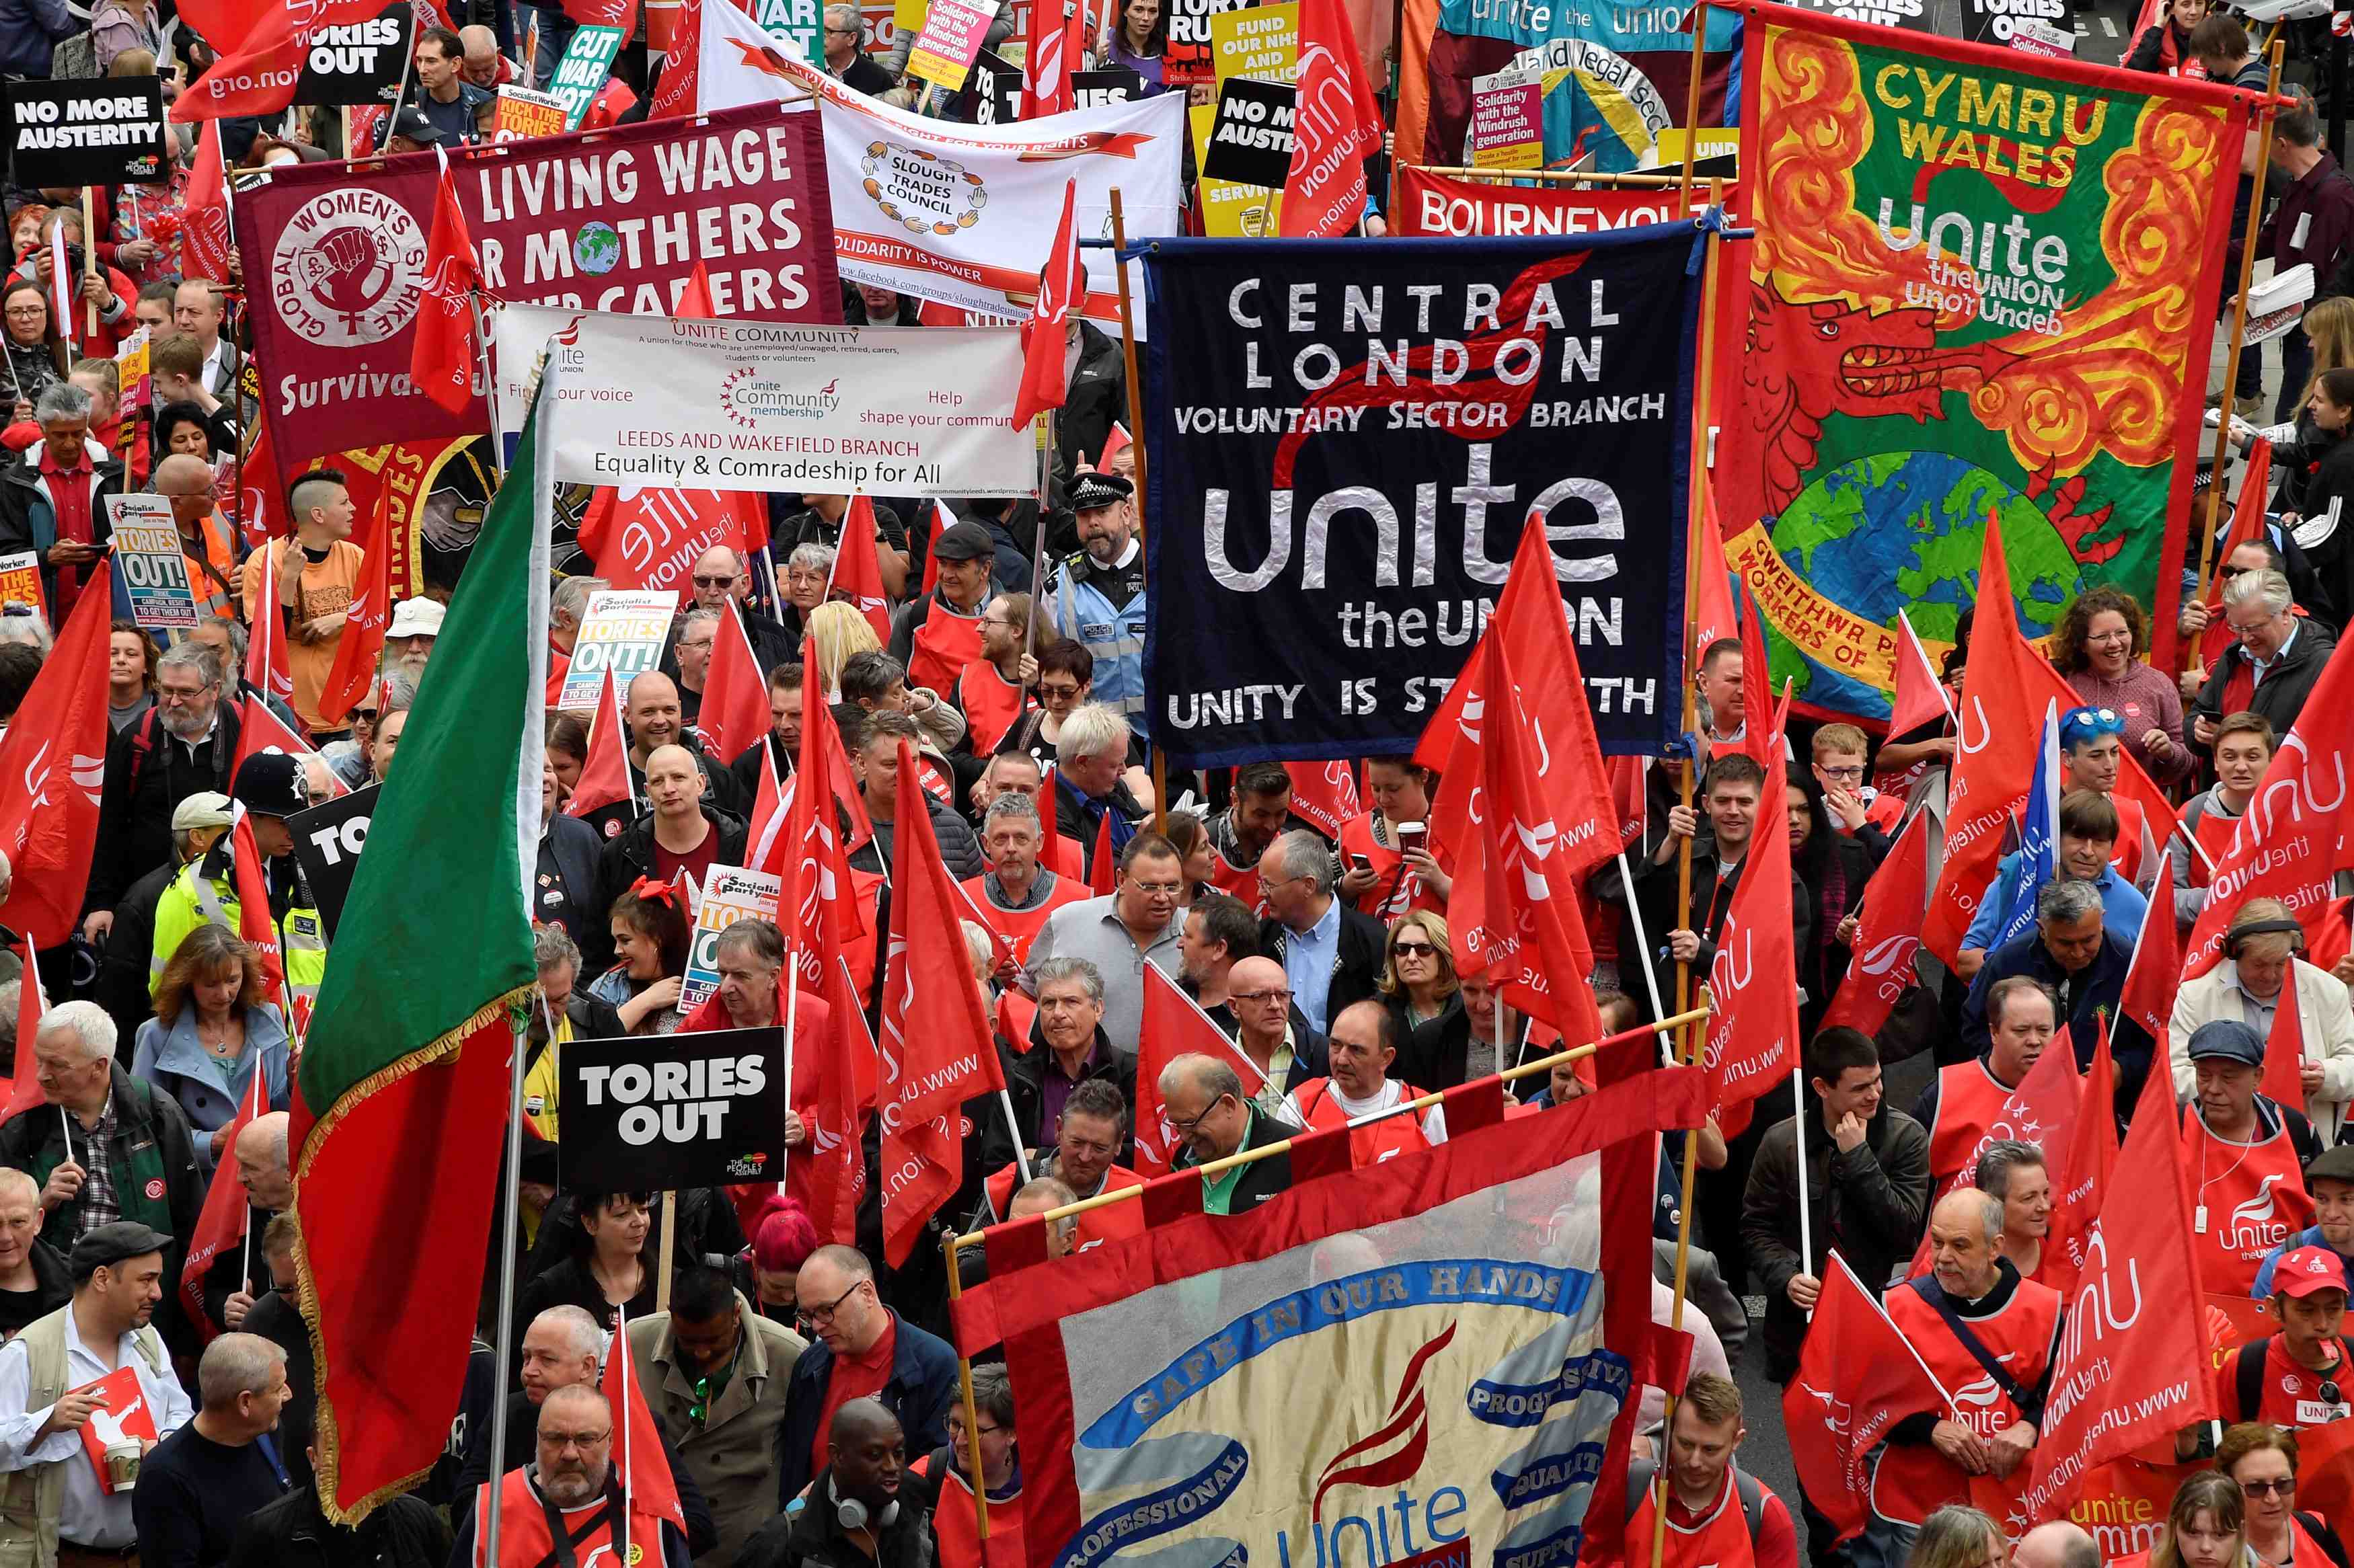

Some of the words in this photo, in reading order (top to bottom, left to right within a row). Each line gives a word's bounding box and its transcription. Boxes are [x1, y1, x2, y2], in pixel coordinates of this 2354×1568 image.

[930, 13, 952, 30] with
[952, 20, 968, 35] the
[935, 1, 979, 27] Solidarity
[1237, 17, 1285, 36] FUND
[1566, 9, 1591, 27] the
[570, 30, 619, 58] CUT
[925, 22, 969, 48] Windrush
[1223, 36, 1261, 55] OUR
[309, 47, 378, 75] OUT
[917, 36, 968, 62] generation
[1245, 52, 1284, 69] AND
[556, 58, 605, 87] WAR
[1579, 42, 1631, 88] legal
[1508, 79, 1527, 87] RACISM
[15, 102, 60, 124] NO
[66, 96, 149, 121] MORE
[500, 97, 533, 118] KICK
[535, 107, 563, 124] THE
[508, 89, 537, 102] Socialist
[538, 96, 562, 108] Worker
[1223, 97, 1266, 122] NO
[1476, 89, 1528, 108] Solidarity
[1875, 64, 2109, 145] CYMRU
[500, 111, 561, 137] TORIES
[1476, 107, 1500, 121] with
[1503, 104, 1520, 117] the
[1476, 114, 1529, 134] Windrush
[16, 121, 161, 151] AUSTERITY
[1215, 122, 1295, 153] AUSTE
[1476, 128, 1534, 149] generation
[1696, 142, 1739, 156] UND
[1897, 117, 2078, 188] WALES
[480, 149, 638, 223] LIVING
[653, 126, 793, 196] WAGE
[891, 156, 956, 184] SLOUGH
[892, 173, 952, 199] TRADES
[886, 184, 954, 216] COUNCIL
[292, 192, 411, 235] WOMEN'S
[1877, 196, 2069, 282] unite
[834, 235, 913, 262] OLIDARITY
[915, 251, 928, 264] IS
[931, 260, 982, 282] POWER
[274, 246, 326, 338] GLOBAL
[1228, 278, 1619, 332] CENTRAL
[1979, 295, 2063, 336] Undeb
[639, 336, 646, 344] A
[646, 337, 671, 345] union
[671, 338, 684, 346] for
[685, 340, 709, 349] those
[710, 342, 728, 351] who
[744, 343, 840, 354] unemployed/unwaged,
[841, 346, 870, 354] retired,
[872, 347, 900, 355] carers,
[673, 322, 730, 341] UNITE
[735, 327, 860, 345] COMMUNITY
[725, 353, 761, 362] students
[772, 354, 817, 363] volunteers
[1246, 336, 1603, 390] LONDON
[558, 387, 586, 402] our
[591, 387, 634, 402] voice
[750, 380, 781, 391] unite
[928, 390, 963, 406] Help
[735, 388, 841, 411] Community
[750, 406, 825, 420] membership
[860, 410, 905, 427] shape
[908, 413, 943, 428] your
[1174, 405, 1367, 435] VOLUNTARY
[1387, 401, 1508, 430] SECTOR
[1529, 394, 1665, 428] BRANCH
[617, 430, 675, 448] LEEDS
[679, 432, 723, 450] AND
[728, 434, 835, 455] WAKEFIELD
[841, 438, 920, 457] BRANCH
[595, 452, 685, 479] Equality
[693, 455, 711, 476] &
[718, 456, 868, 485] Comradeship
[874, 461, 907, 484] for
[913, 464, 942, 485] All
[121, 510, 143, 519] Party
[122, 502, 155, 512] Socialist
[1203, 443, 1625, 592] unite
[116, 529, 179, 552] TORIES
[126, 553, 186, 588] OUT!
[1755, 539, 1866, 644] GWEITHWR
[139, 607, 149, 615] TO
[161, 609, 180, 617] THEM
[180, 609, 193, 617] OUT
[599, 604, 632, 613] Party
[1737, 546, 1827, 650] WORKERS
[1834, 645, 1868, 669] OF
[583, 619, 667, 640] TORIES
[1084, 624, 1112, 633] POLICE
[575, 641, 658, 672] OUT!
[1168, 683, 1305, 730] UNITY
[1341, 677, 1378, 715] IS
[1404, 676, 1655, 715] STTH
[722, 885, 763, 899] Party
[728, 875, 780, 895] Socialis
[579, 1054, 766, 1105] TORIES
[618, 1101, 730, 1146] OUT
[2219, 1220, 2287, 1251] unite
[1133, 1337, 1238, 1420] SAFE
[1252, 1300, 1301, 1343] IN
[1320, 1272, 1409, 1317] OUR
[1428, 1267, 1561, 1304] HANDS
[1512, 1452, 1602, 1497] QUALIT
[1064, 1454, 1246, 1568] ROFESSIONAL
[2070, 1493, 2154, 1524] unite
